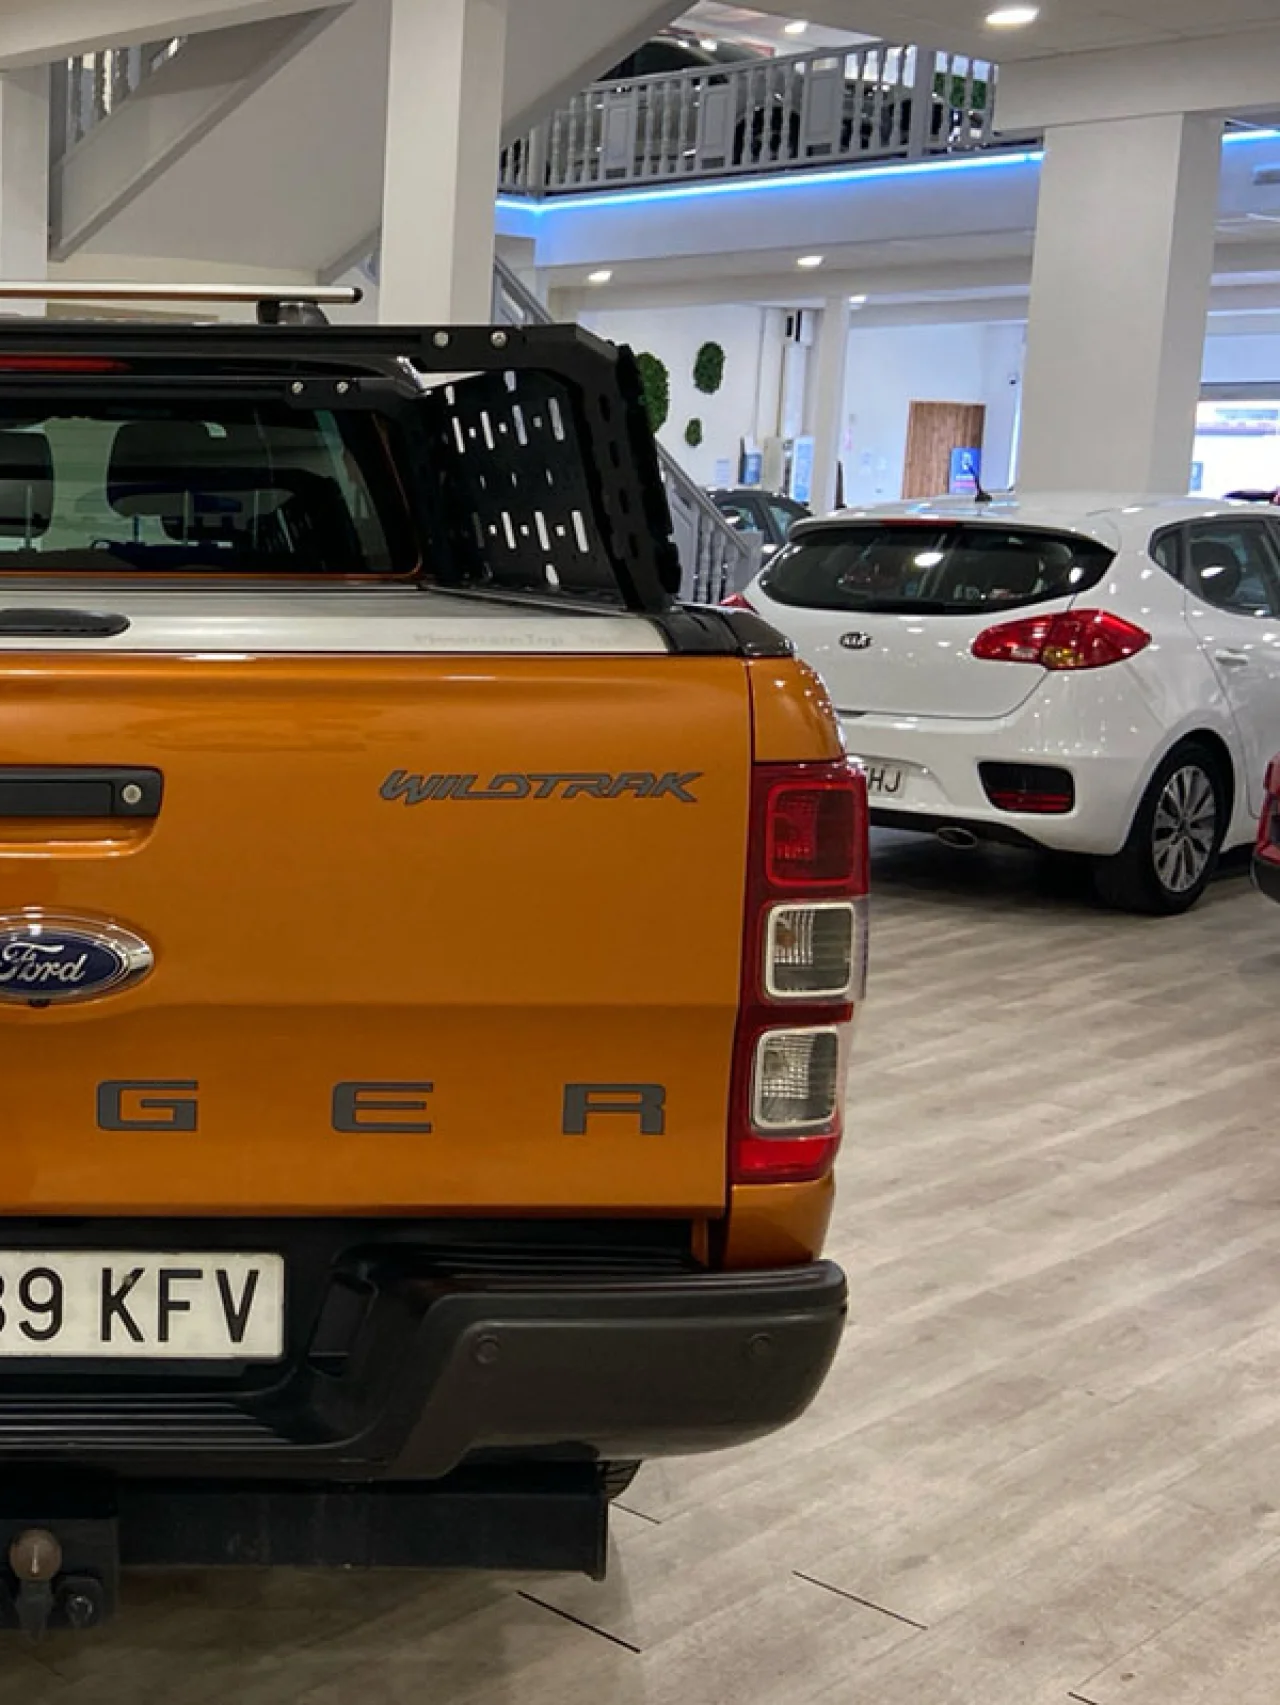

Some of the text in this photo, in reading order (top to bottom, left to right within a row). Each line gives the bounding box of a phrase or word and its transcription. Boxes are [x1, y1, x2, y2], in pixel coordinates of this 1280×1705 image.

[380, 769, 703, 806] WILDTRAK
[863, 766, 901, 792] HJ
[101, 1267, 259, 1342] KFV
